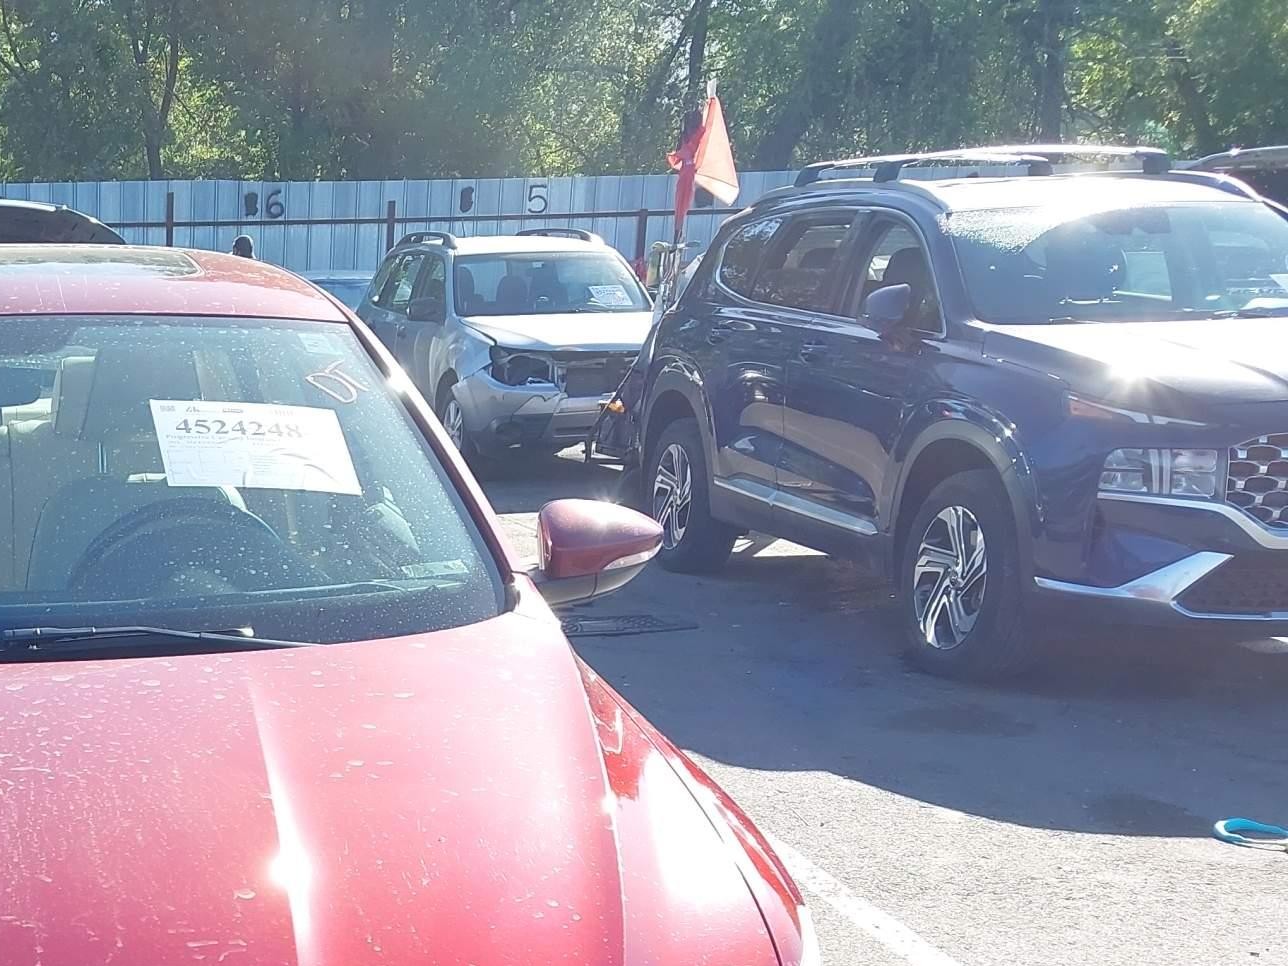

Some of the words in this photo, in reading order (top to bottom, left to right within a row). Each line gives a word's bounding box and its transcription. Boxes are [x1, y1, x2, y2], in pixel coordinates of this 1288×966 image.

[265, 189, 285, 219] 6
[527, 184, 549, 214] 5
[175, 418, 310, 438] 4524248
